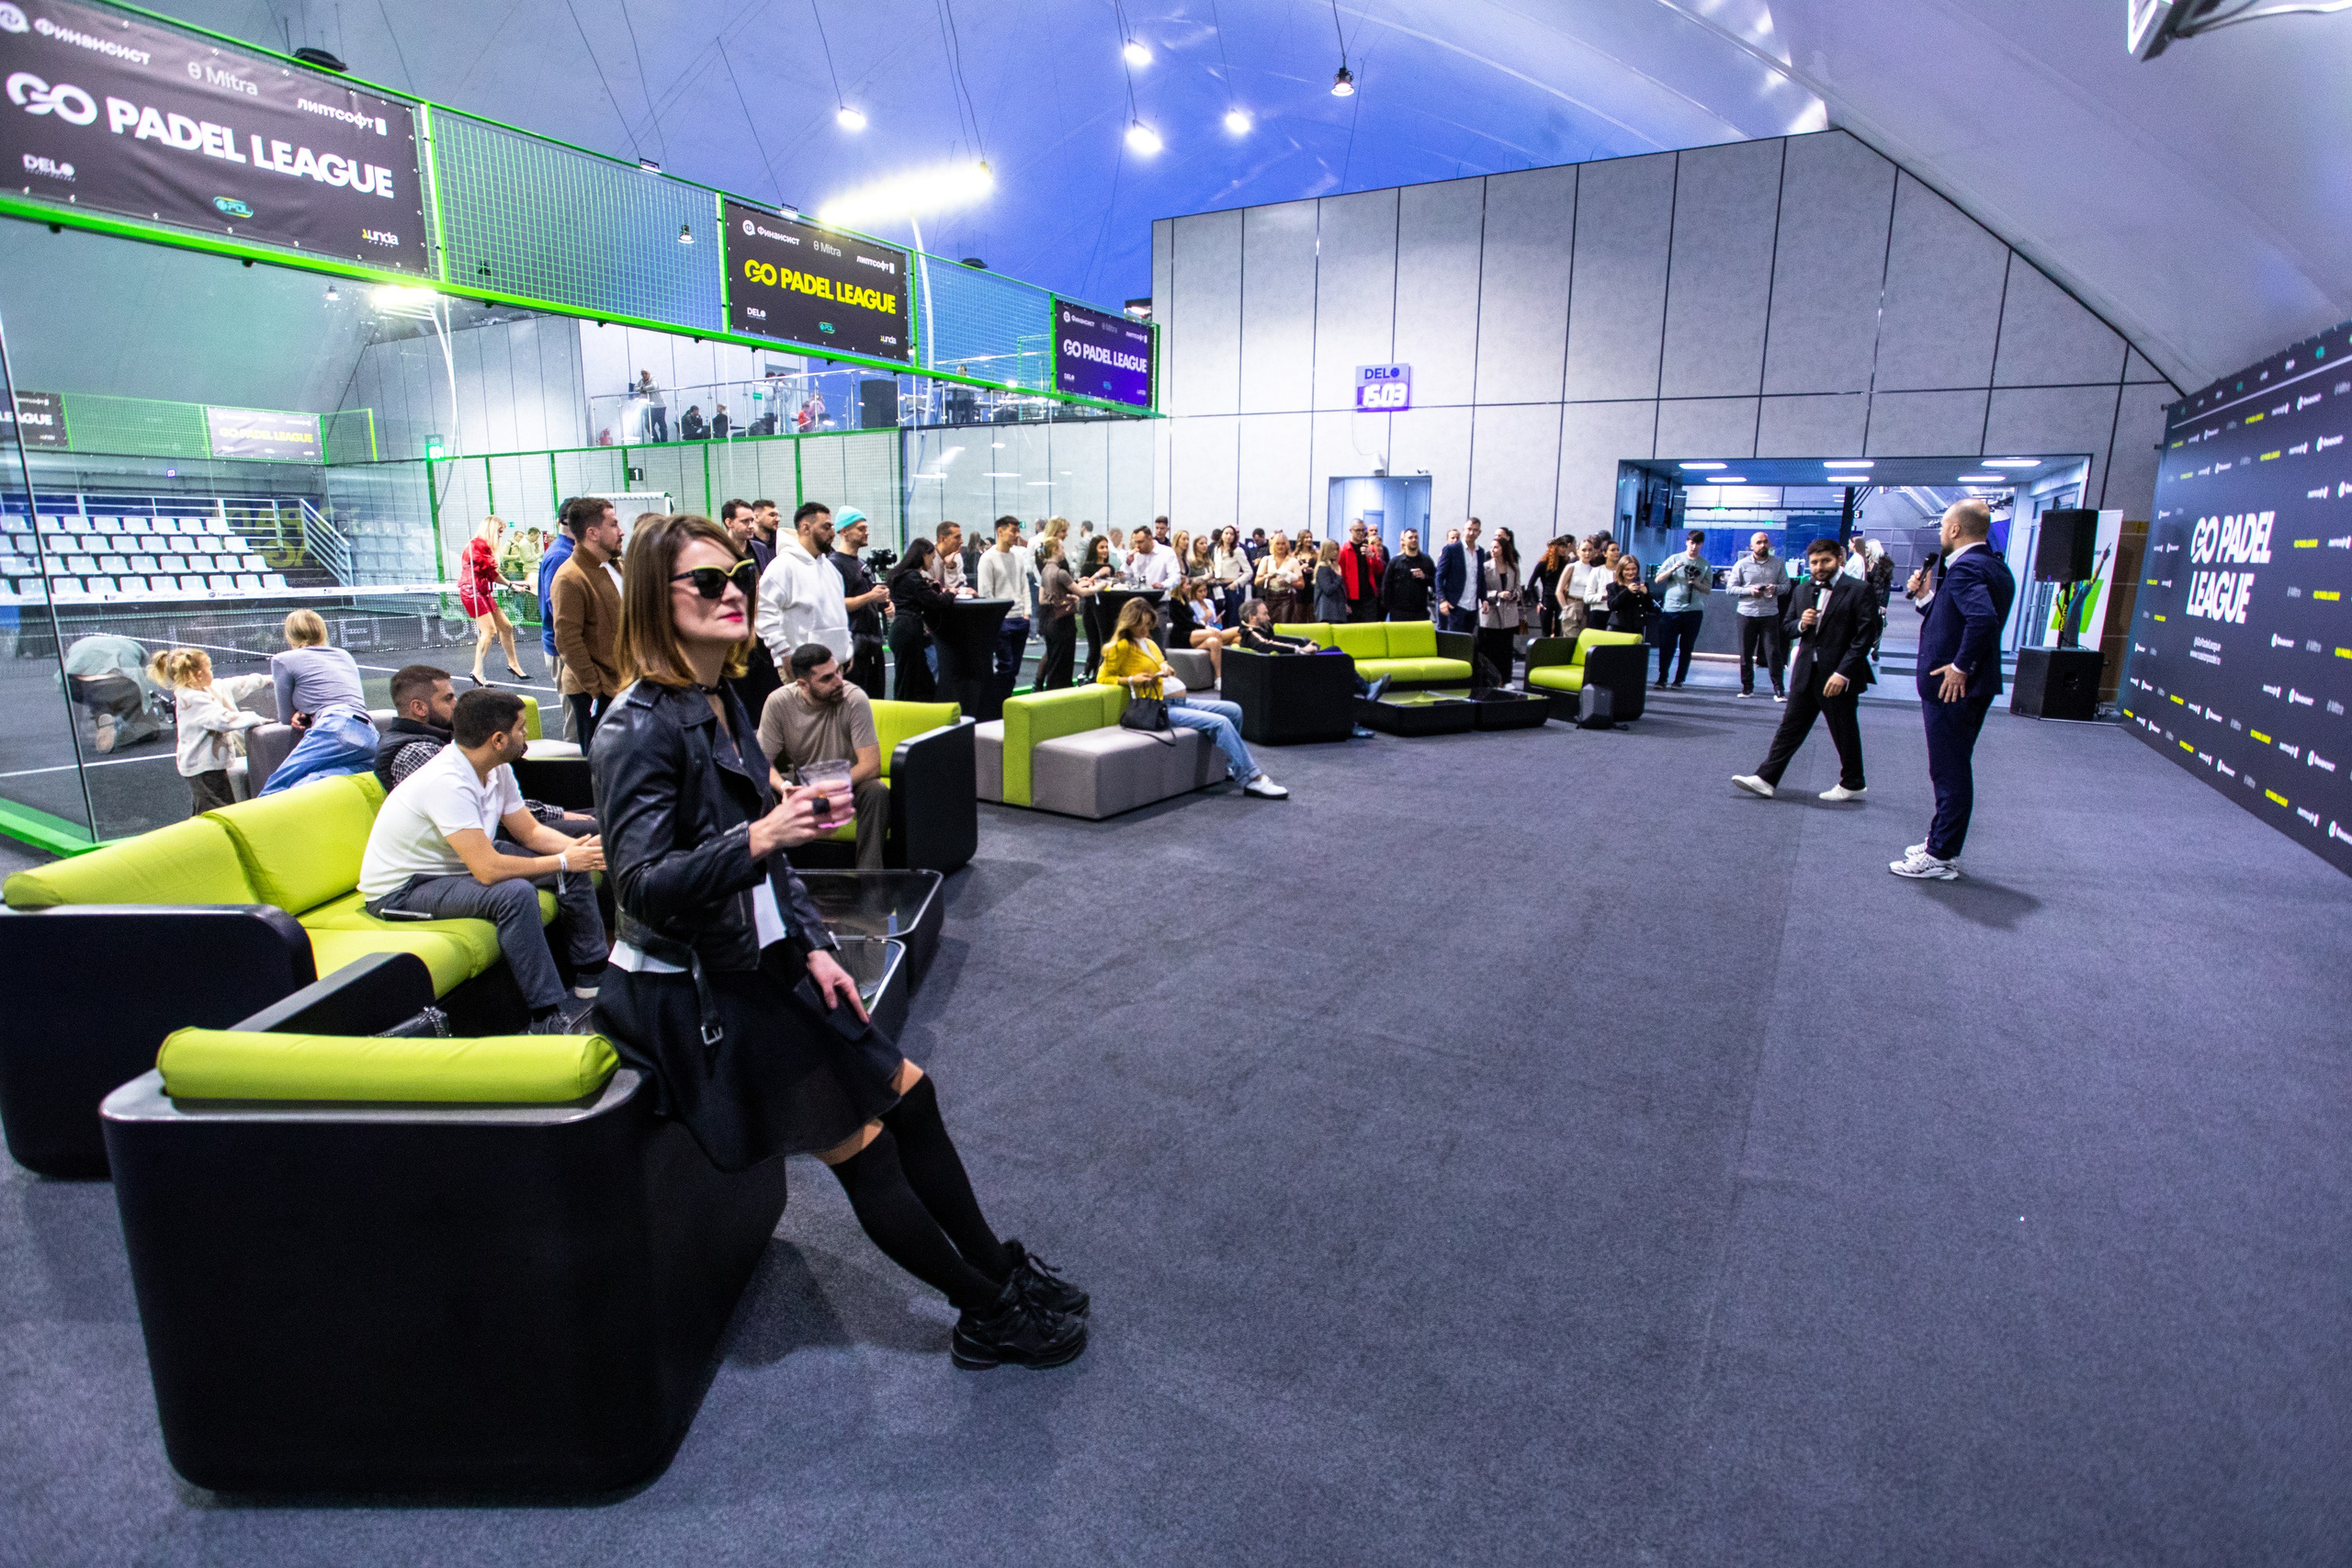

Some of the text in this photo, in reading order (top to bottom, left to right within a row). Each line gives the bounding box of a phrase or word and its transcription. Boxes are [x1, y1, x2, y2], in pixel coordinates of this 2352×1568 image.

[34, 17, 151, 65] Финансист
[205, 66, 258, 96] Mitra
[298, 97, 374, 130] липтсофт
[6, 72, 395, 198] GO PADEL LEAGUE
[757, 226, 800, 246] Финансист
[820, 241, 842, 257] Mitra
[744, 259, 896, 314] GO PADEL LEAGUE
[1063, 339, 1147, 373] GO PADEL LEAGUE
[634, 468, 639, 480] 1
[2190, 510, 2276, 564] GO PADEL
[2186, 570, 2255, 624] LEAGUE
